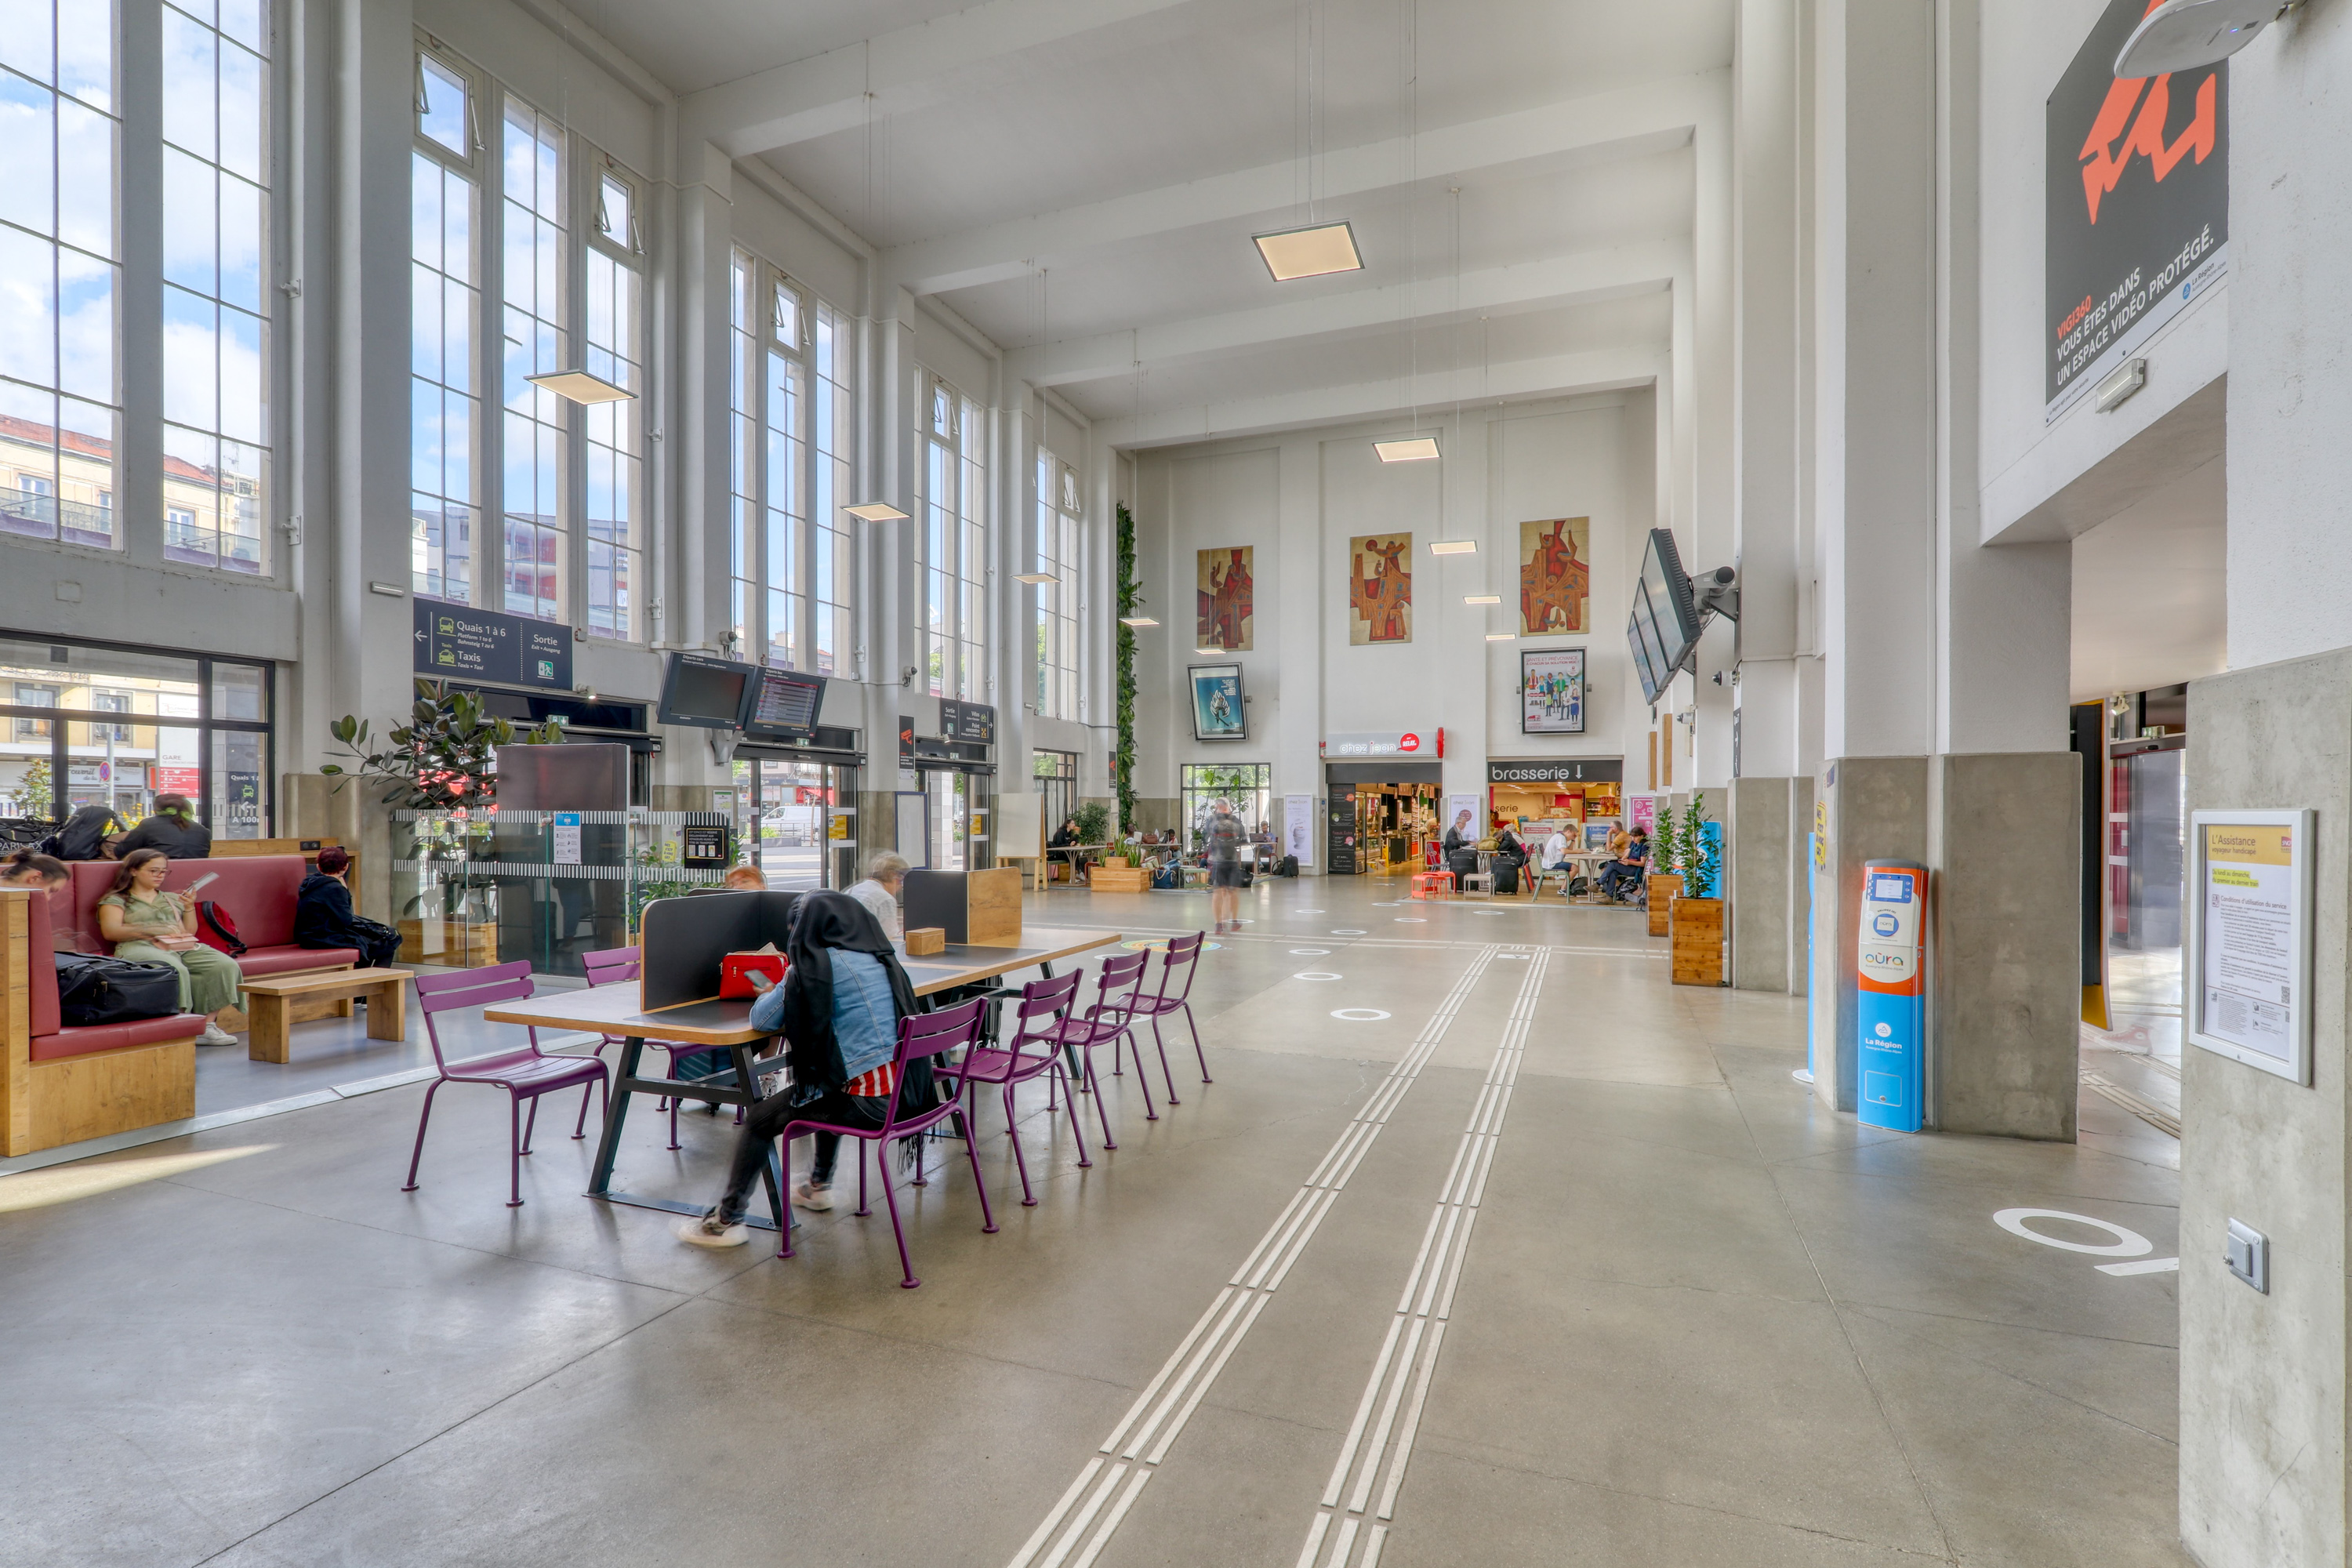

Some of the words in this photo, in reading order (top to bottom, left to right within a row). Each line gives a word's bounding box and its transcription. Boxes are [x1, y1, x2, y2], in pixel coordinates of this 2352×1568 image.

[2198, 263, 2215, 280] Région
[2057, 361, 2071, 386] UN
[2072, 325, 2108, 372] ESPACE
[2111, 290, 2146, 334] VIDÉO
[2149, 223, 2214, 301] PROTÉGÉ.
[2057, 326, 2082, 361] VOUS
[2084, 300, 2107, 337] ÊTES
[2110, 267, 2140, 311] DANS
[2057, 295, 2092, 340] VIGI360
[456, 621, 483, 633] Quais
[486, 626, 490, 634] 1
[492, 627, 498, 636] à
[500, 628, 506, 637] 6
[457, 639, 481, 648] Bahnsteig
[533, 633, 558, 646] Sortie
[457, 651, 481, 662] Taxis
[543, 646, 561, 655] Ausgang
[1340, 742, 1368, 754] chez
[1370, 741, 1396, 755] jean
[1492, 766, 1570, 781] brasserie
[2212, 835, 2256, 846] L'Assistance
[2233, 847, 2256, 855] handicapé
[2220, 895, 2241, 904] Conditions
[1875, 1039, 1902, 1049] Région
